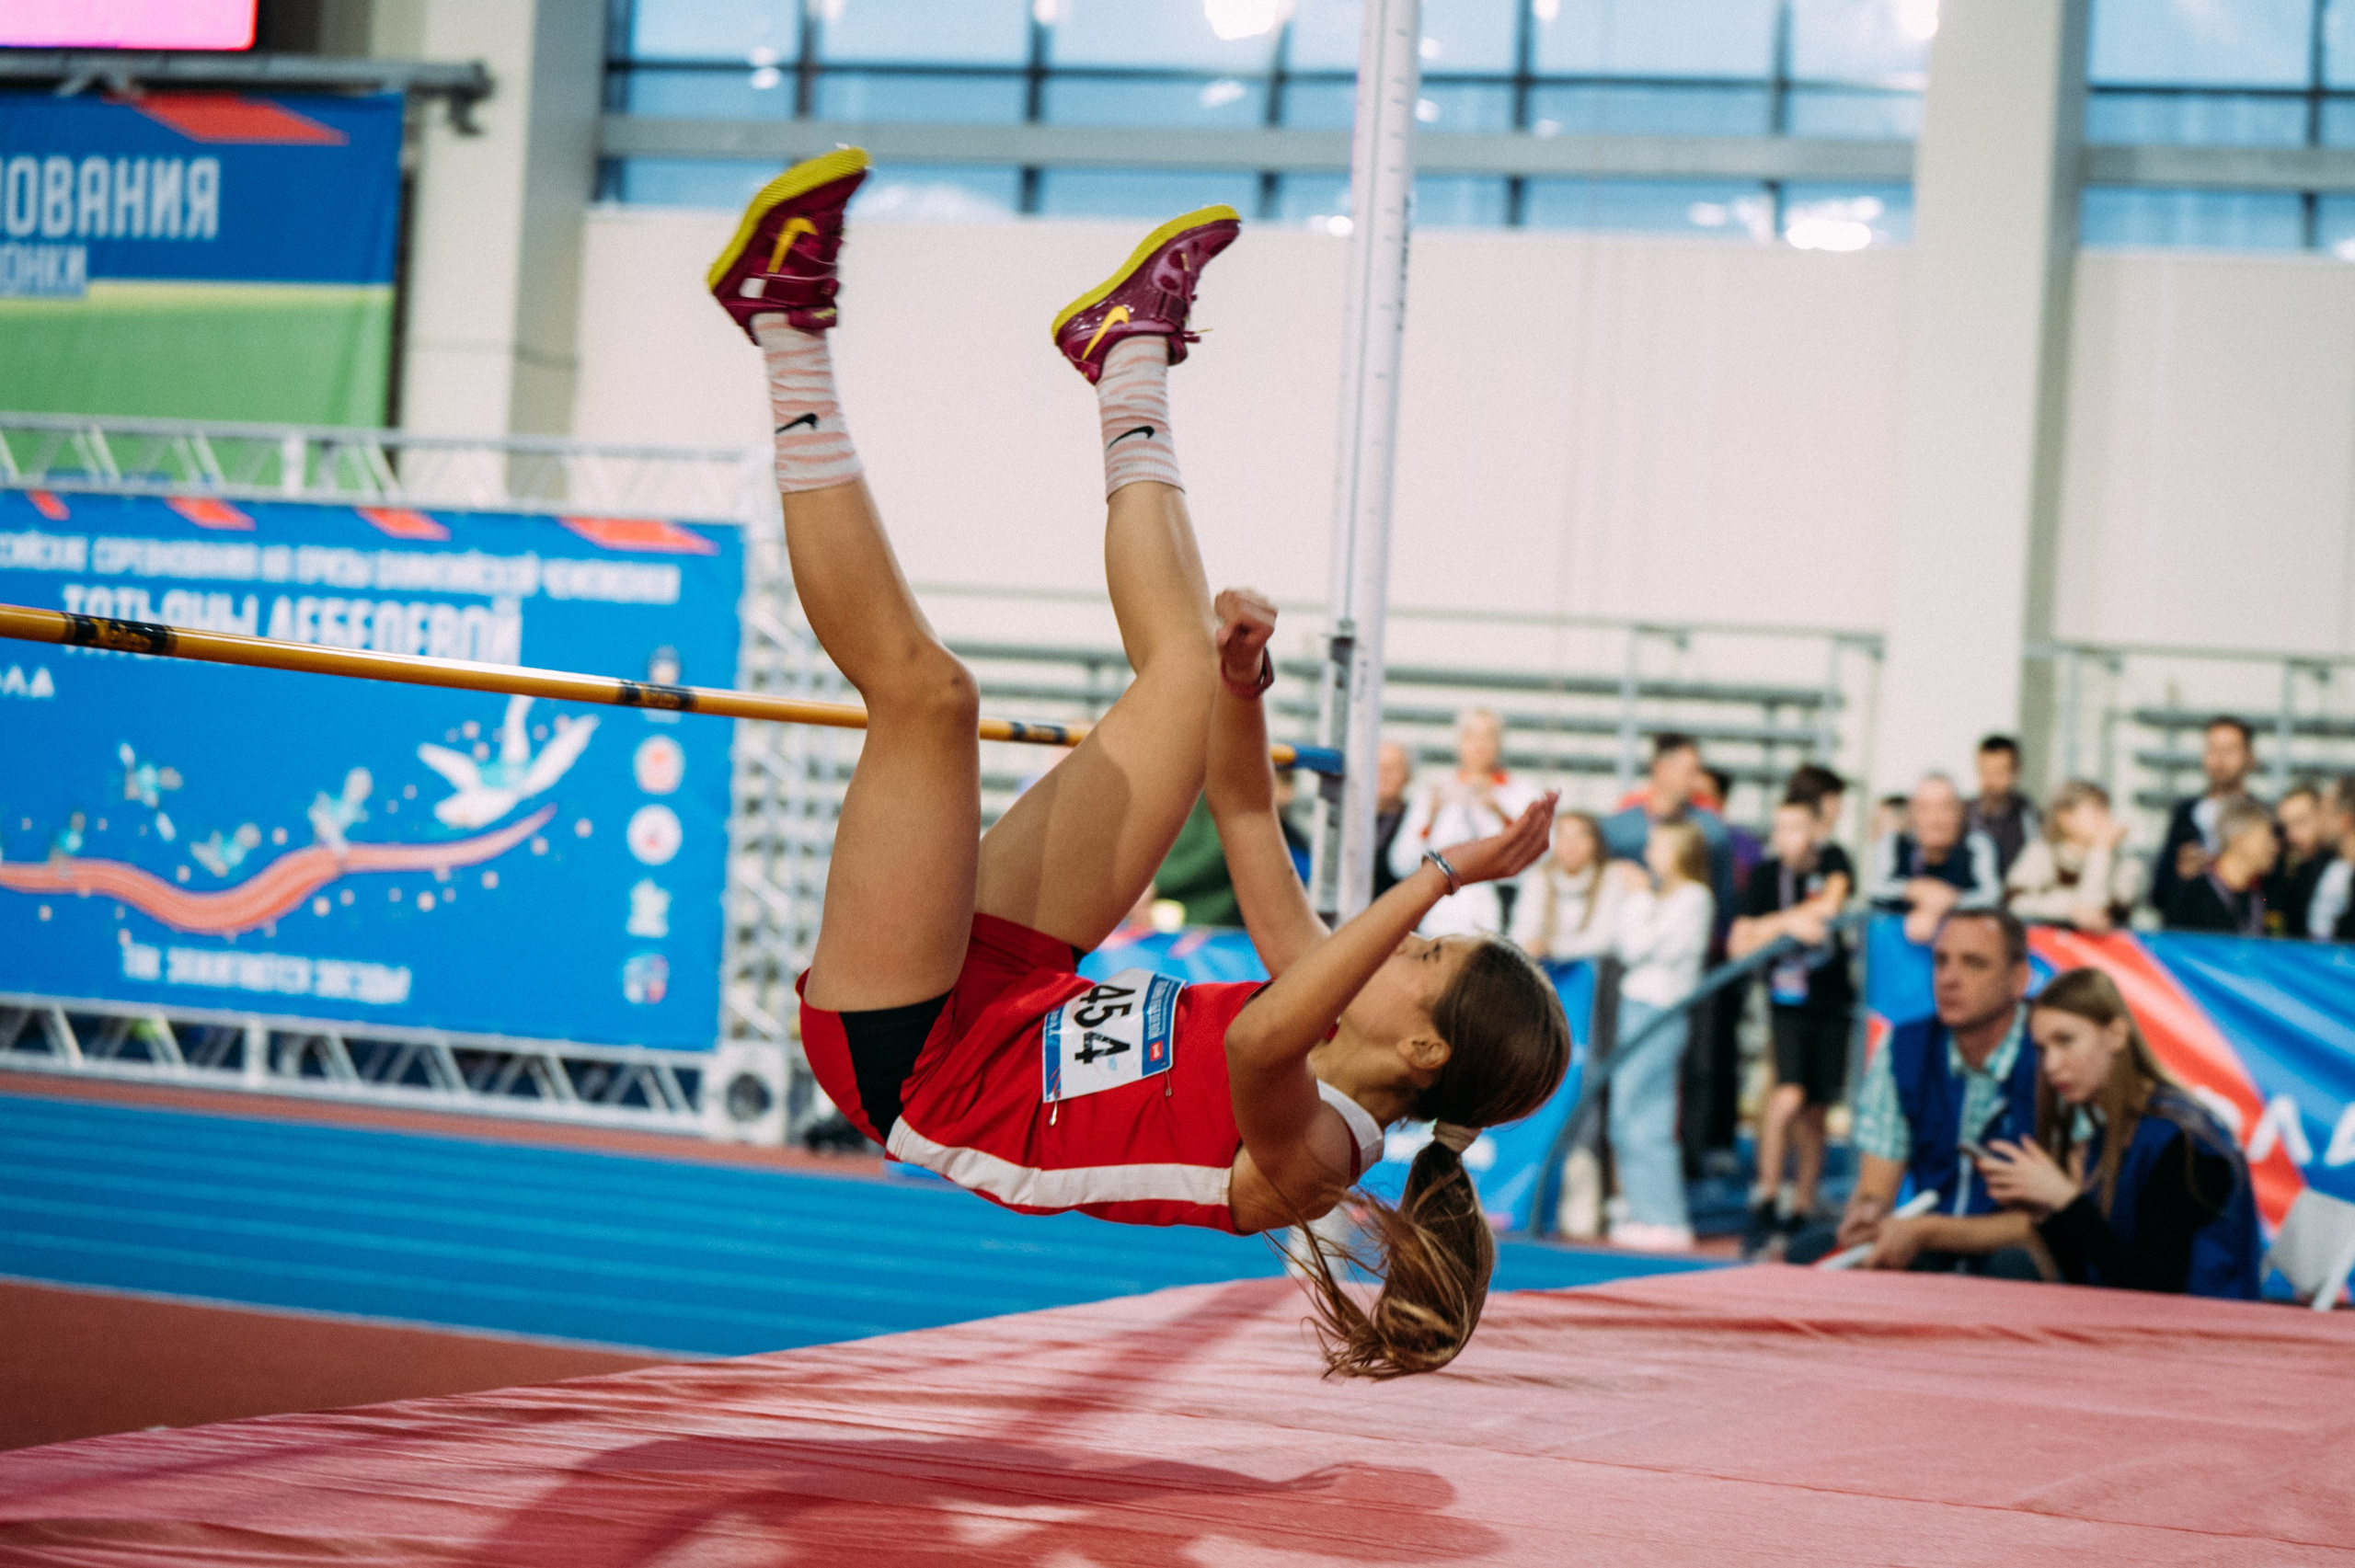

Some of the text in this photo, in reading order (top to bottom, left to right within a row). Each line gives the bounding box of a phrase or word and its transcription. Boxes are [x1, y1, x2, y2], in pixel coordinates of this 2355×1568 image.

[0, 153, 221, 239] ОВАНИЯ
[0, 243, 87, 287] ОНКИ
[1073, 984, 1136, 1065] 454
